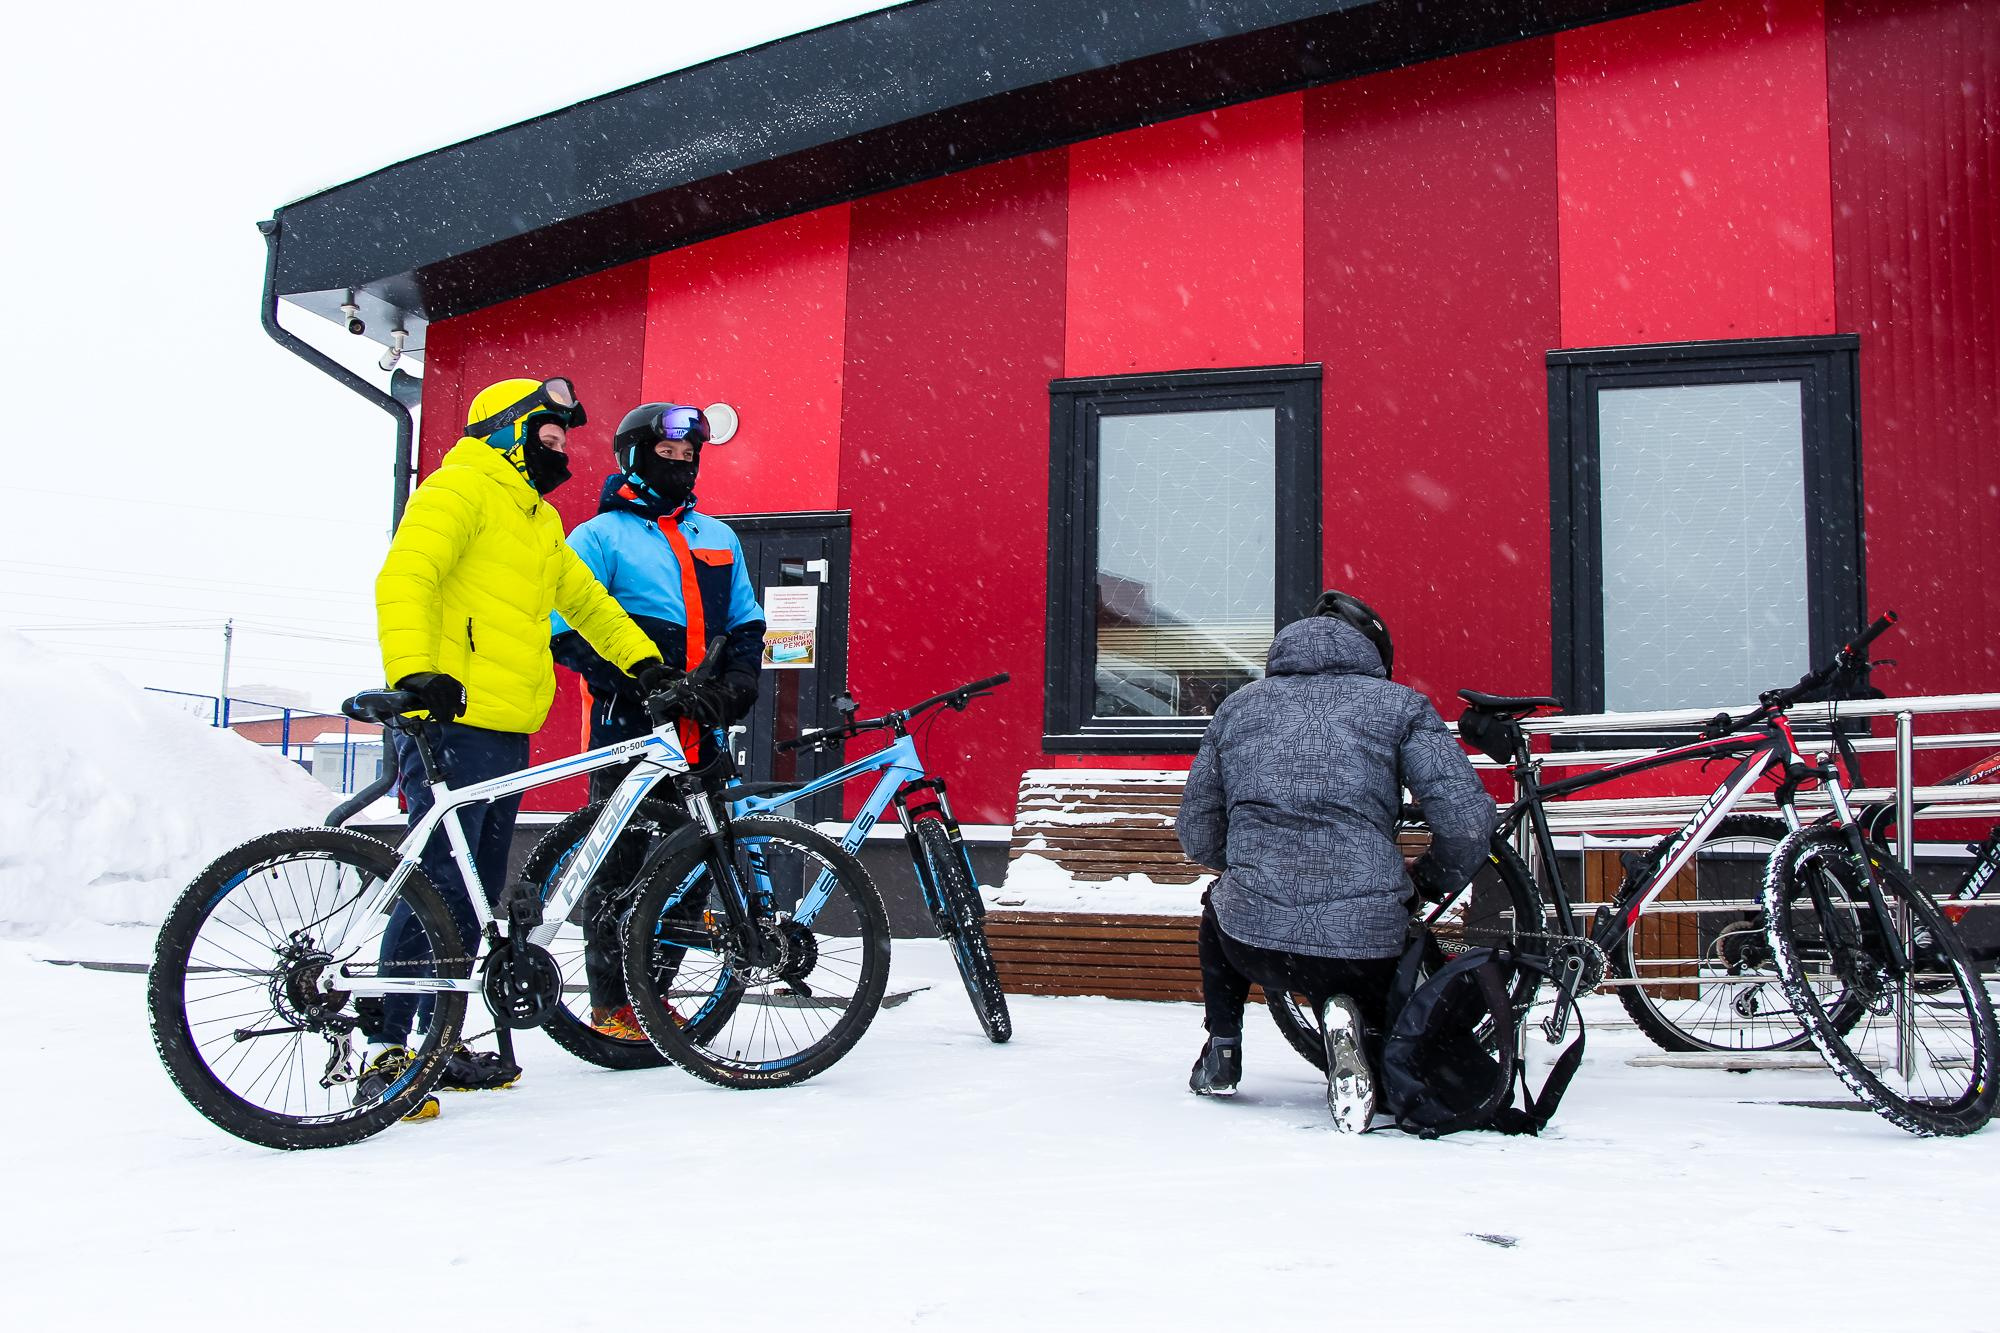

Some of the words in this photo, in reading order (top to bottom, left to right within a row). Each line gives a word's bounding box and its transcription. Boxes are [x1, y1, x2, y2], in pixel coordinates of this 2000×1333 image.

[783, 638, 813, 650] РЕЖИМ
[610, 740, 646, 756] MD-500
[1653, 782, 1729, 879] JAMIS
[247, 850, 334, 877] PULSE
[562, 793, 631, 906] PULSE
[769, 836, 837, 870] PULSE
[689, 1043, 763, 1071] PULSE
[297, 1094, 384, 1125] PULSE
